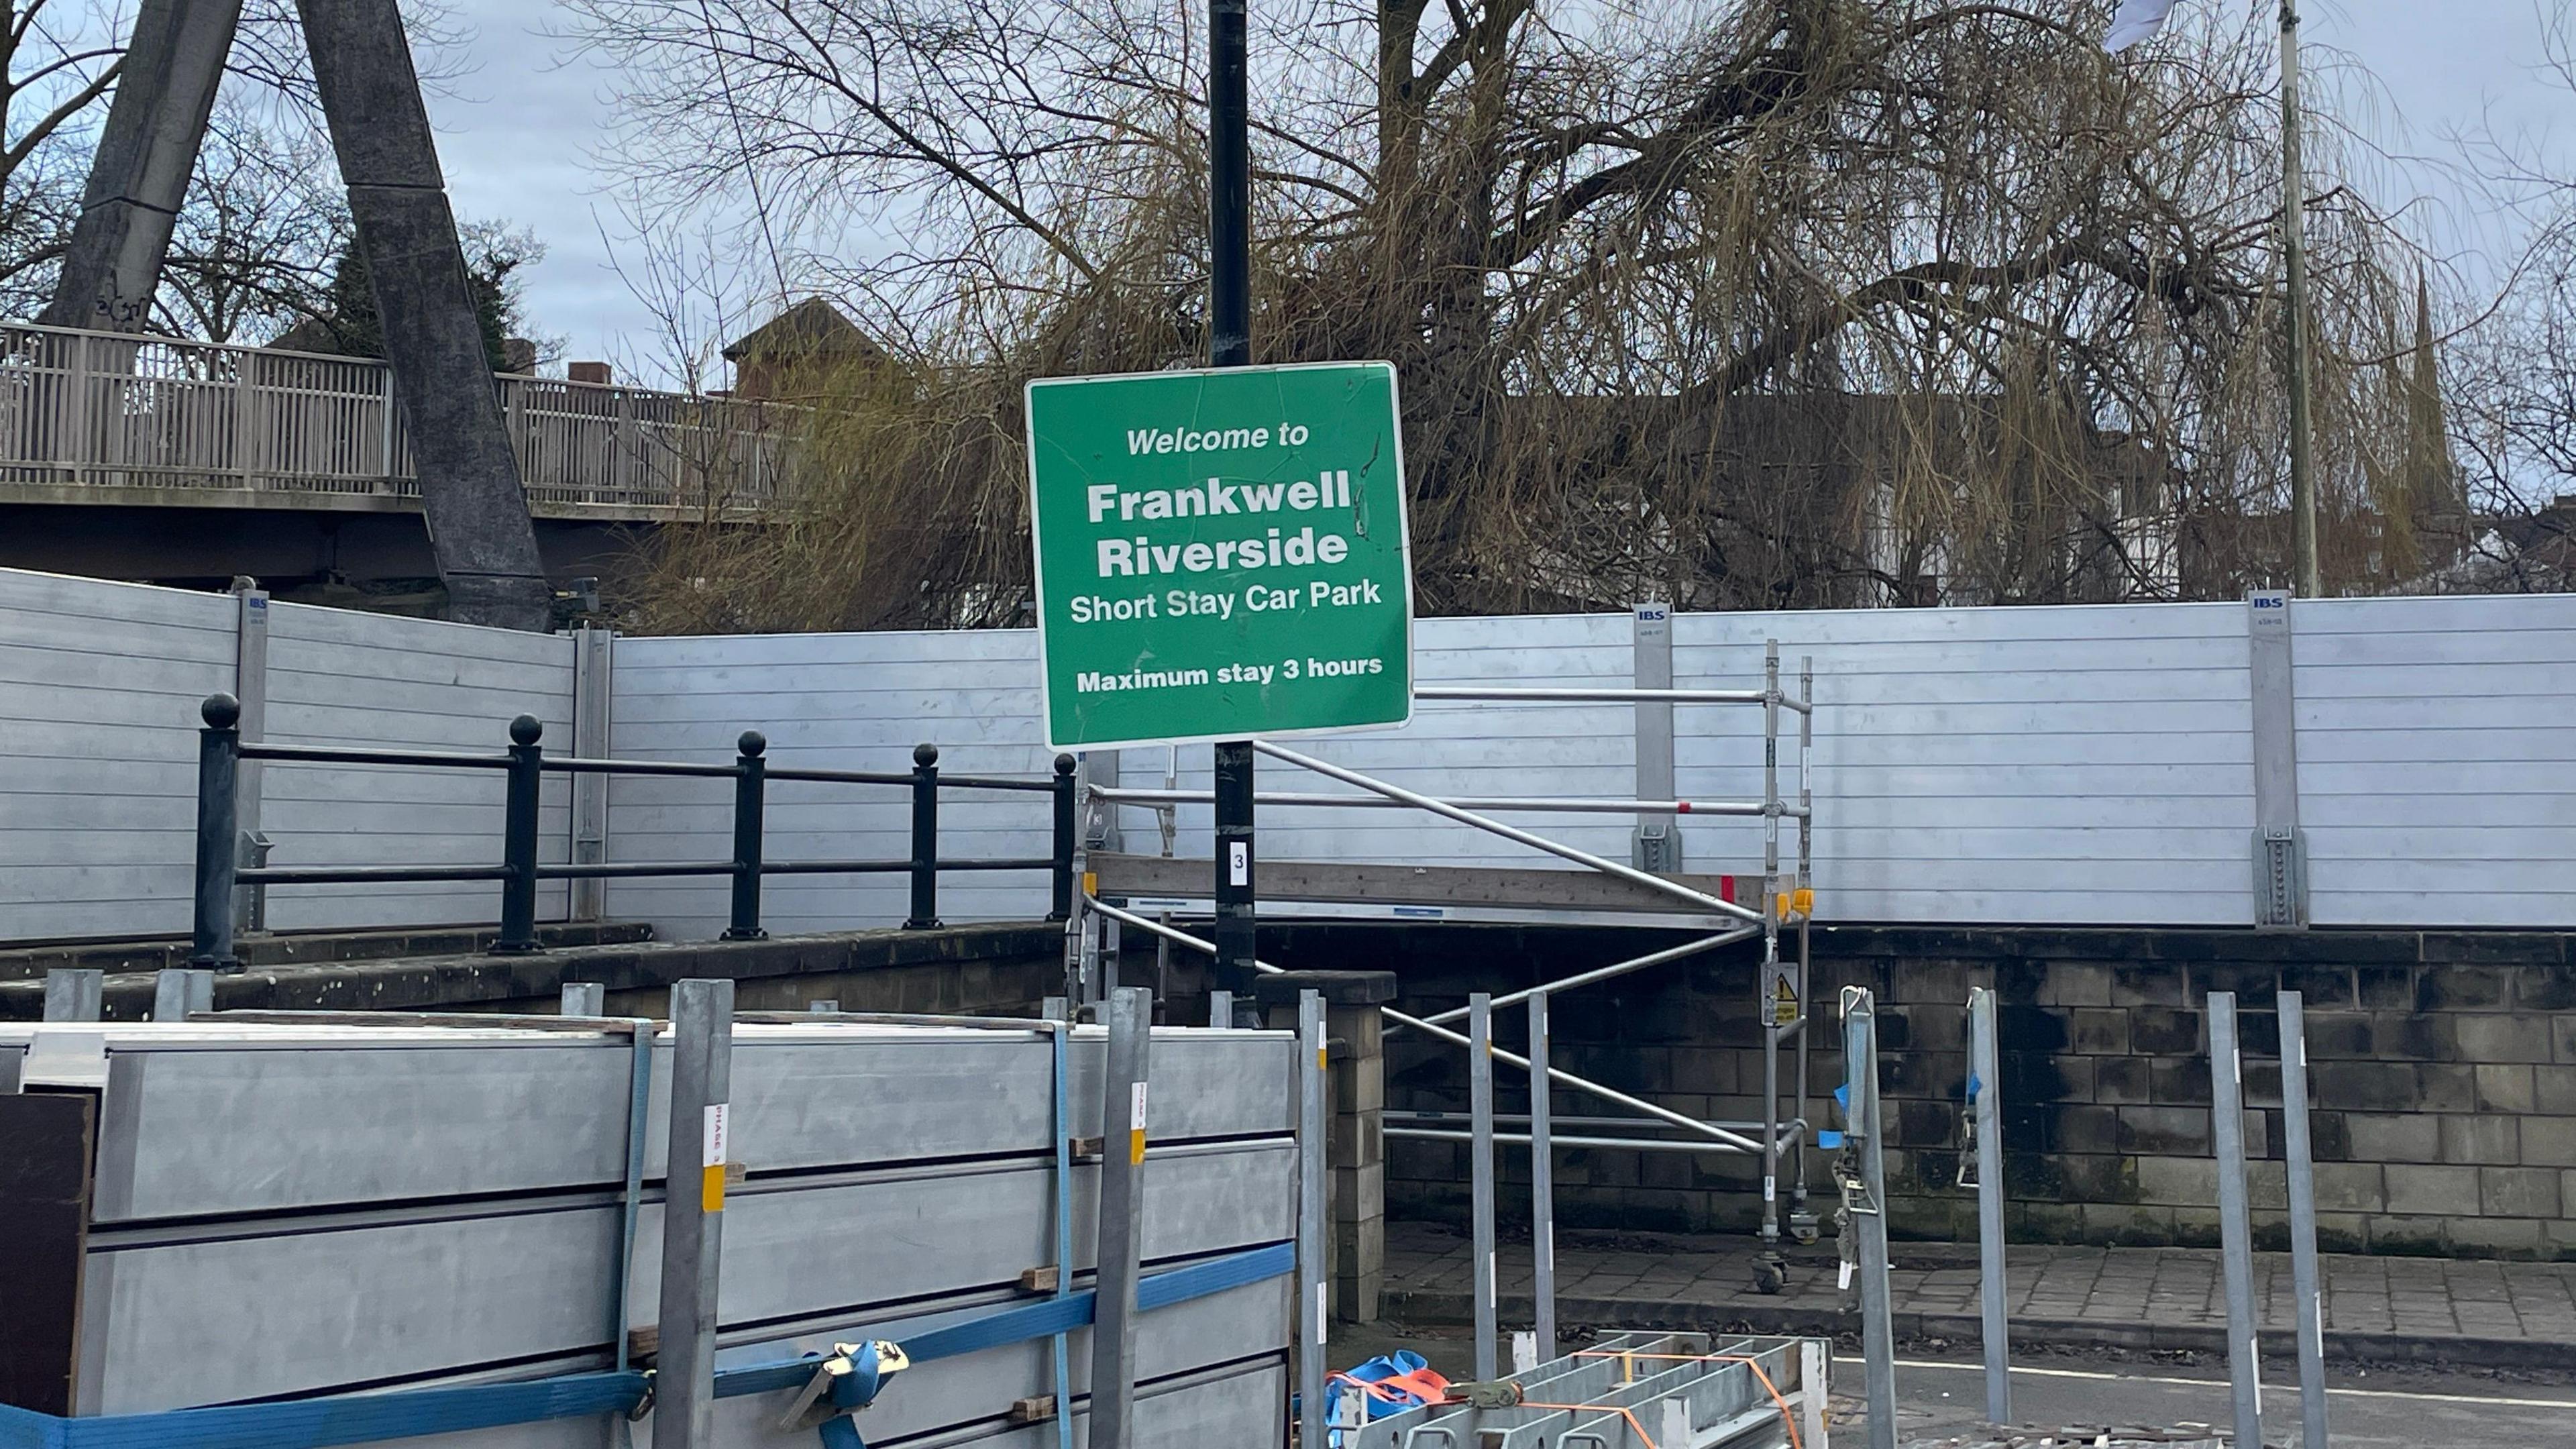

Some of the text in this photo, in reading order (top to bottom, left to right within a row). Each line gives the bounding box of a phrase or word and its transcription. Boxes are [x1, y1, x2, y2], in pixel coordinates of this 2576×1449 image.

[1127, 422, 1309, 455] Welcome to
[1087, 470, 1350, 523] Frankwell
[1097, 527, 1348, 577] Riverside
[250, 598, 267, 609] IBS
[1071, 578, 1382, 623] Short Stay Car Park
[1639, 610, 1665, 621] IBS
[2253, 598, 2283, 608] IBS
[1077, 657, 1383, 692] Maximum stay 3 hours
[1234, 854, 1243, 869] 3
